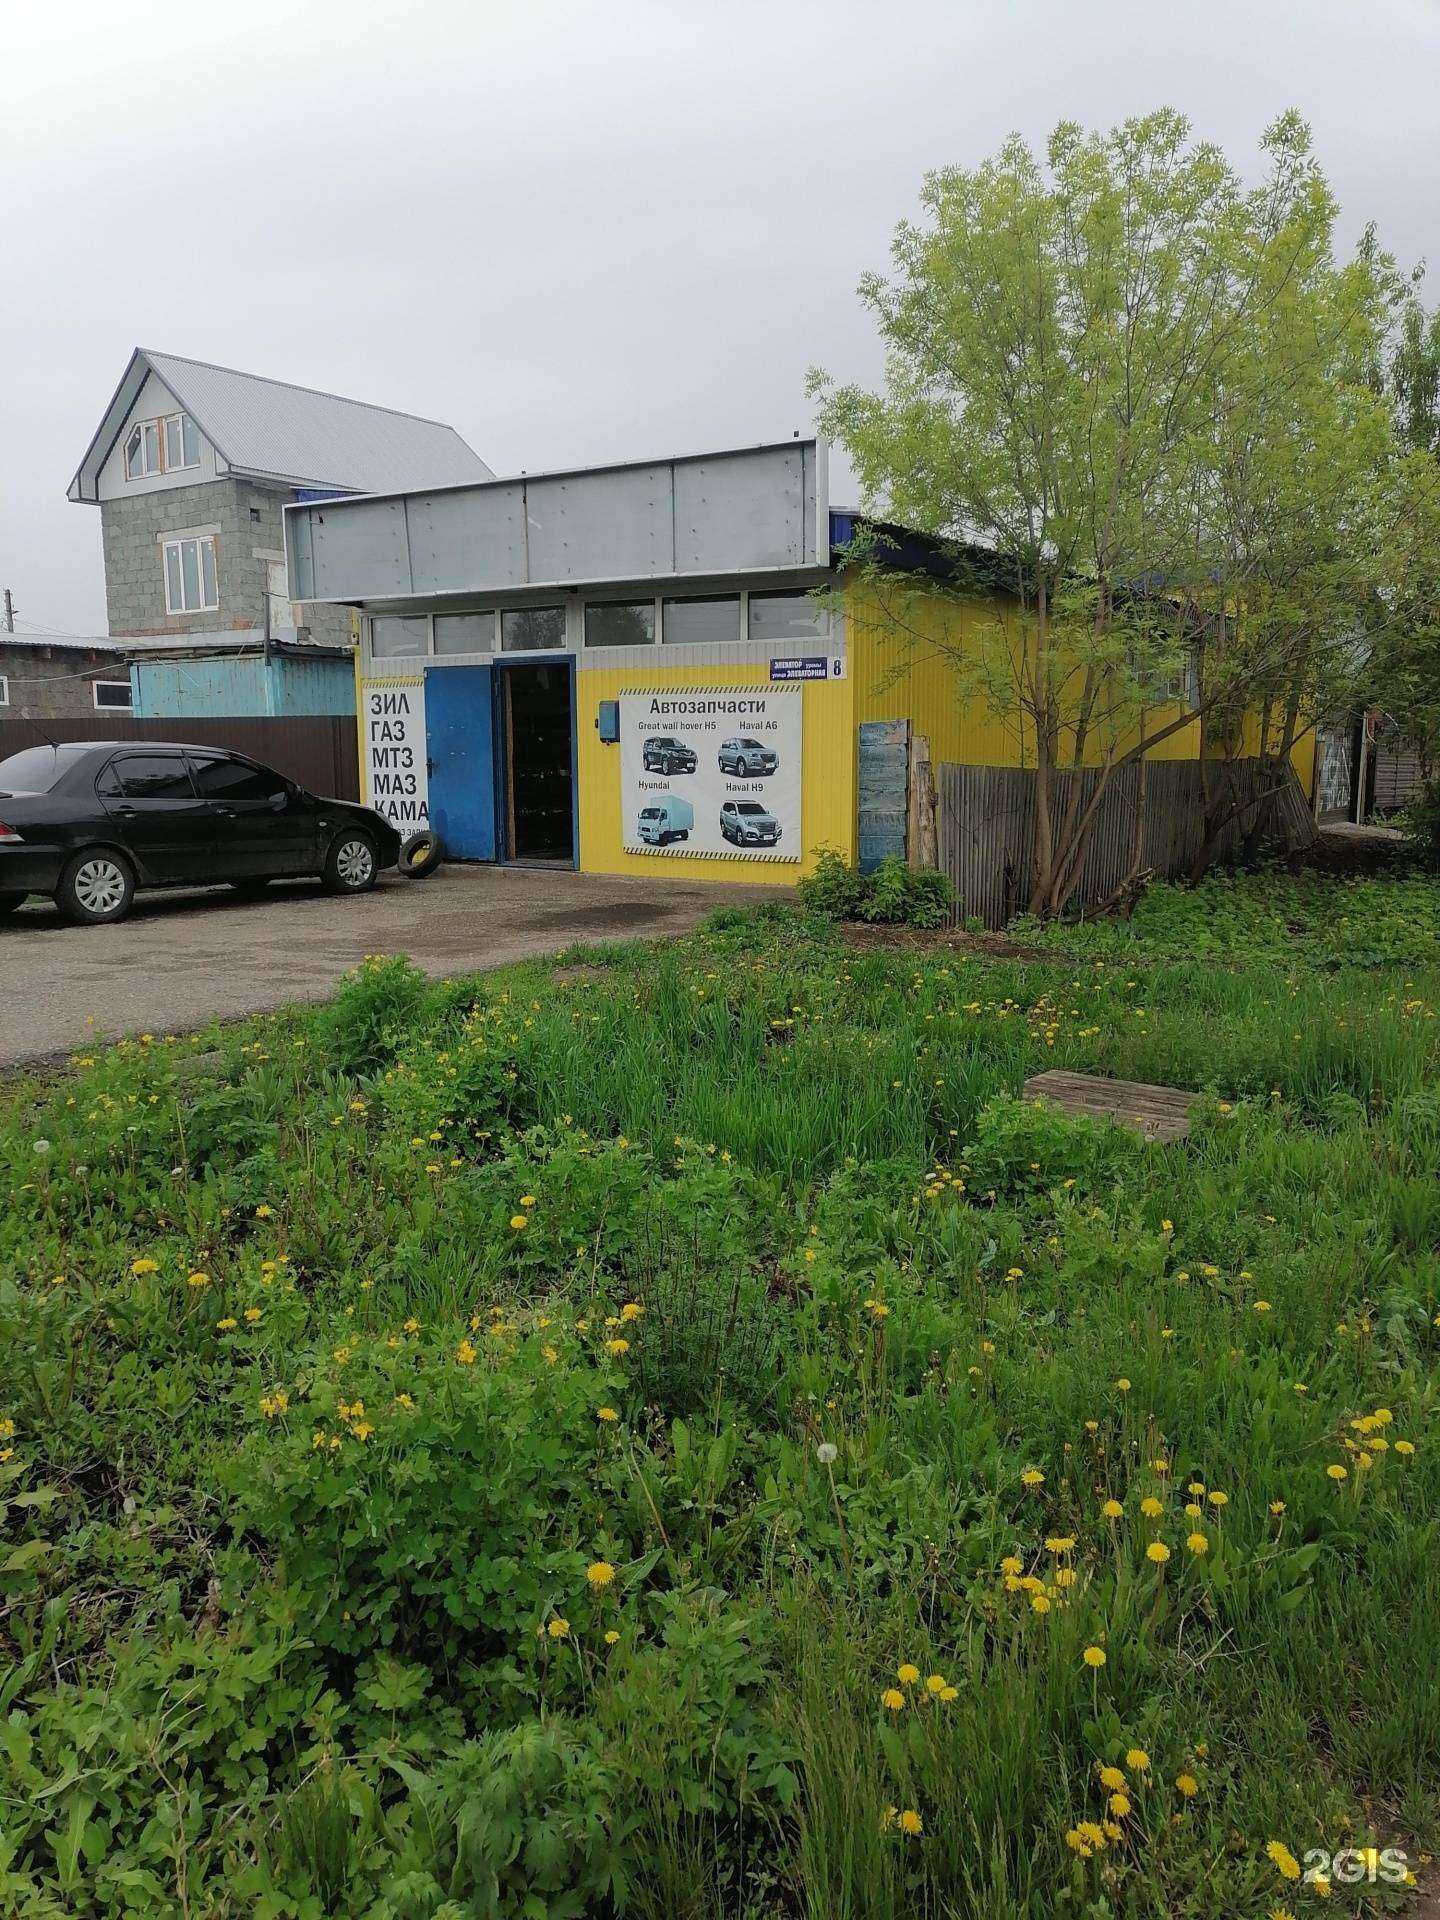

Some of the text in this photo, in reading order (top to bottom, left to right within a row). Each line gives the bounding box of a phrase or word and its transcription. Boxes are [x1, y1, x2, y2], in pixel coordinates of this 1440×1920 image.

[833, 659, 842, 676] 8
[371, 693, 411, 715] ЗИЛ
[650, 698, 766, 714] Автозапчасти
[371, 720, 406, 742] ГАЗ
[638, 720, 717, 730] Great wall hover H5
[739, 720, 778, 730] Haval A6
[372, 747, 414, 768] МТЗ
[374, 773, 417, 795] МАЗ
[638, 780, 670, 791] Hyundai
[726, 782, 764, 792] Haval H9
